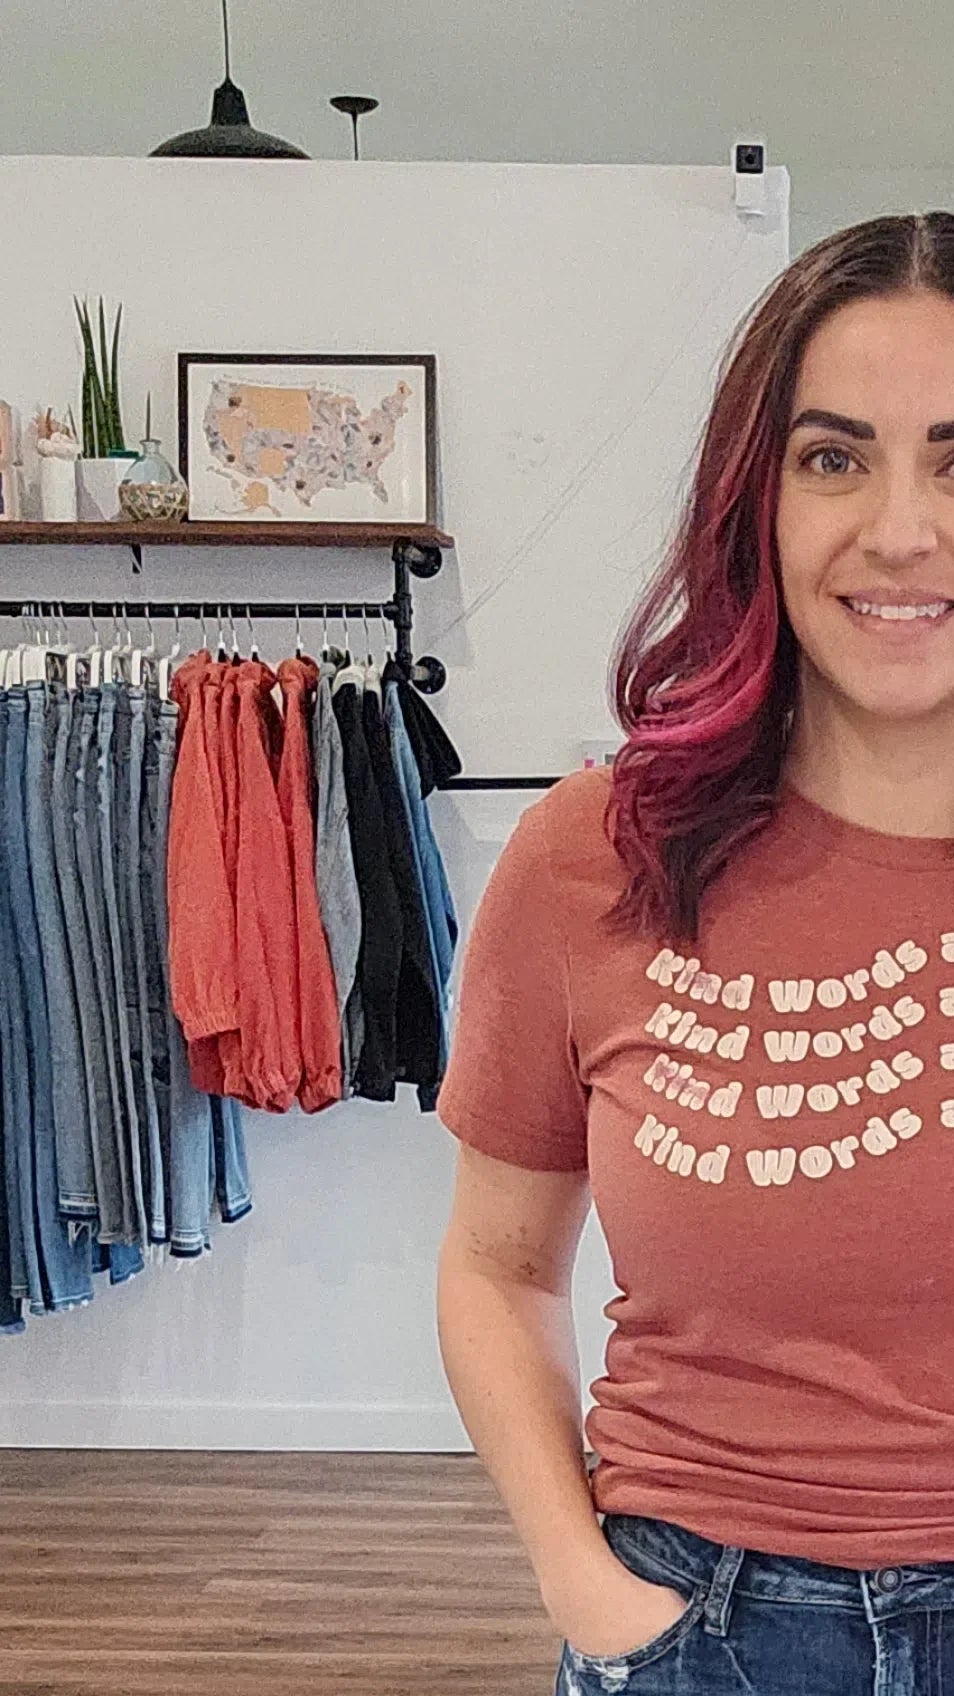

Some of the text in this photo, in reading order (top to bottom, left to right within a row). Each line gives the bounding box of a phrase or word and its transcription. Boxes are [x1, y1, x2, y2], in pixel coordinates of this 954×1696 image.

[768, 940, 928, 1013] words
[763, 995, 926, 1063] words
[756, 1050, 924, 1119] words
[746, 1107, 923, 1187] words
